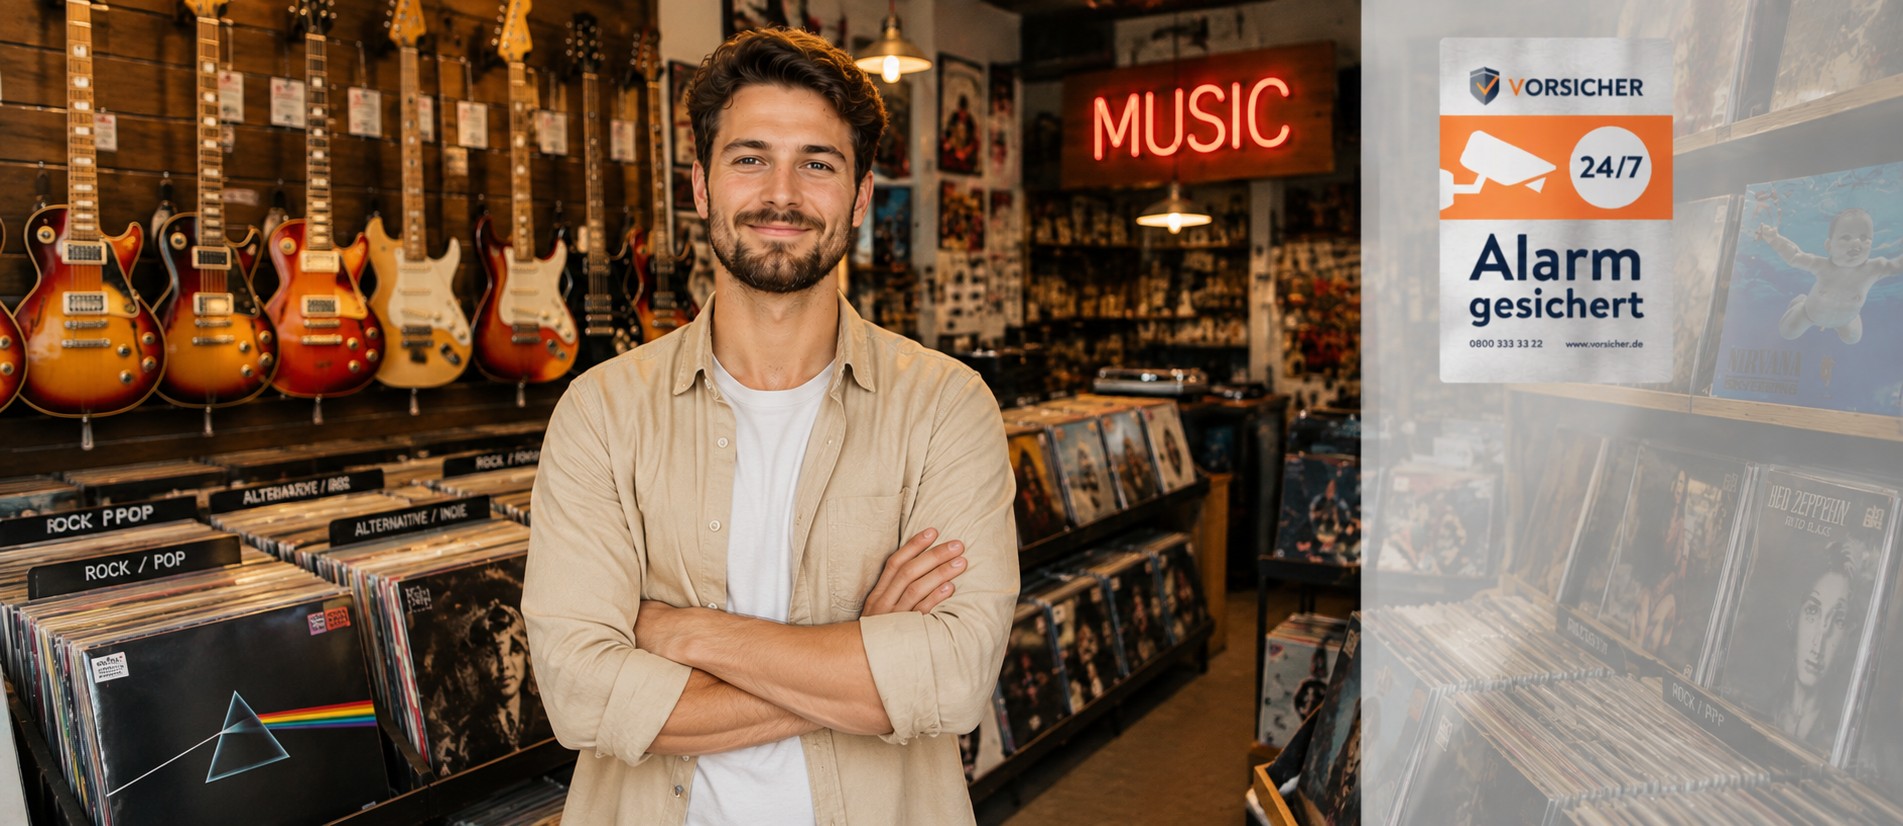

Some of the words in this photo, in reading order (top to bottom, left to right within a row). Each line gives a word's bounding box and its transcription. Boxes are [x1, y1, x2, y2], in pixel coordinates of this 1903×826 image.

[1508, 78, 1643, 96] VORSICHER
[1094, 77, 1290, 161] MUSIC
[1580, 155, 1643, 178] 24/7
[1469, 233, 1641, 281] Alarm
[1469, 287, 1645, 327] gesichert
[1469, 339, 1494, 348] 0800
[1497, 339, 1514, 348] 333
[1517, 339, 1529, 348] 33
[1530, 339, 1543, 348] 22
[1565, 339, 1644, 349] www.vorsicher.de
[1727, 348, 1802, 377] NIRVANA
[46, 512, 93, 534] ROCK
[440, 504, 468, 521] INDIE
[85, 560, 131, 581] ROCK
[138, 556, 147, 573] /
[154, 551, 186, 570] POP
